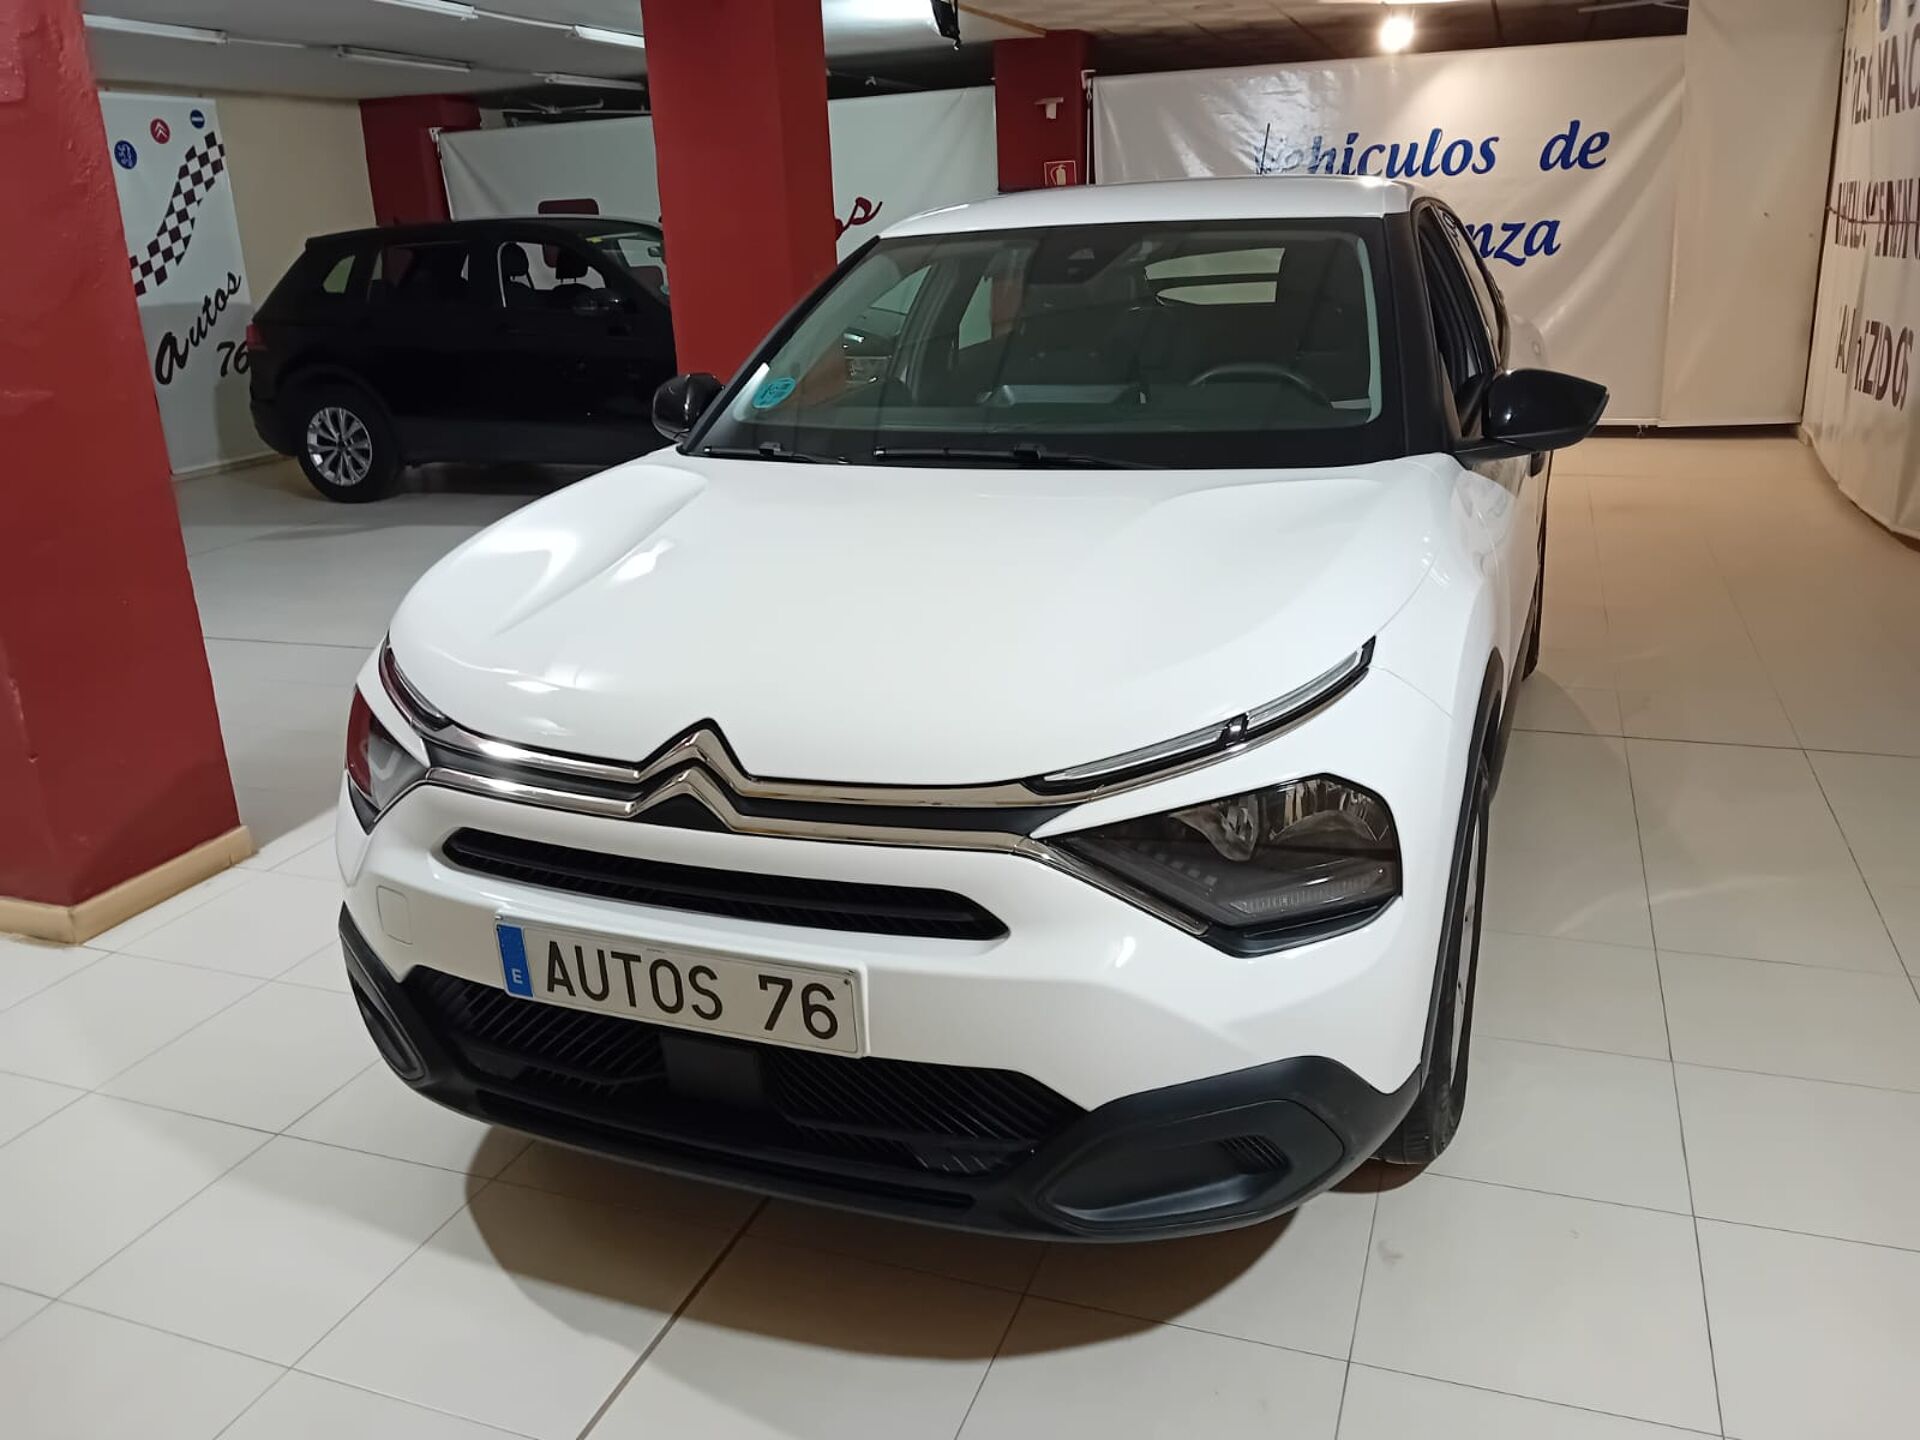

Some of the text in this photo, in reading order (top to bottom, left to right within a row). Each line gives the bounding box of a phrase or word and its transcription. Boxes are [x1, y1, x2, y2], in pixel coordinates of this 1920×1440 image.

[1540, 119, 1611, 172] de
[216, 341, 251, 377] 76
[511, 940, 839, 1040] E AUTOS 76
